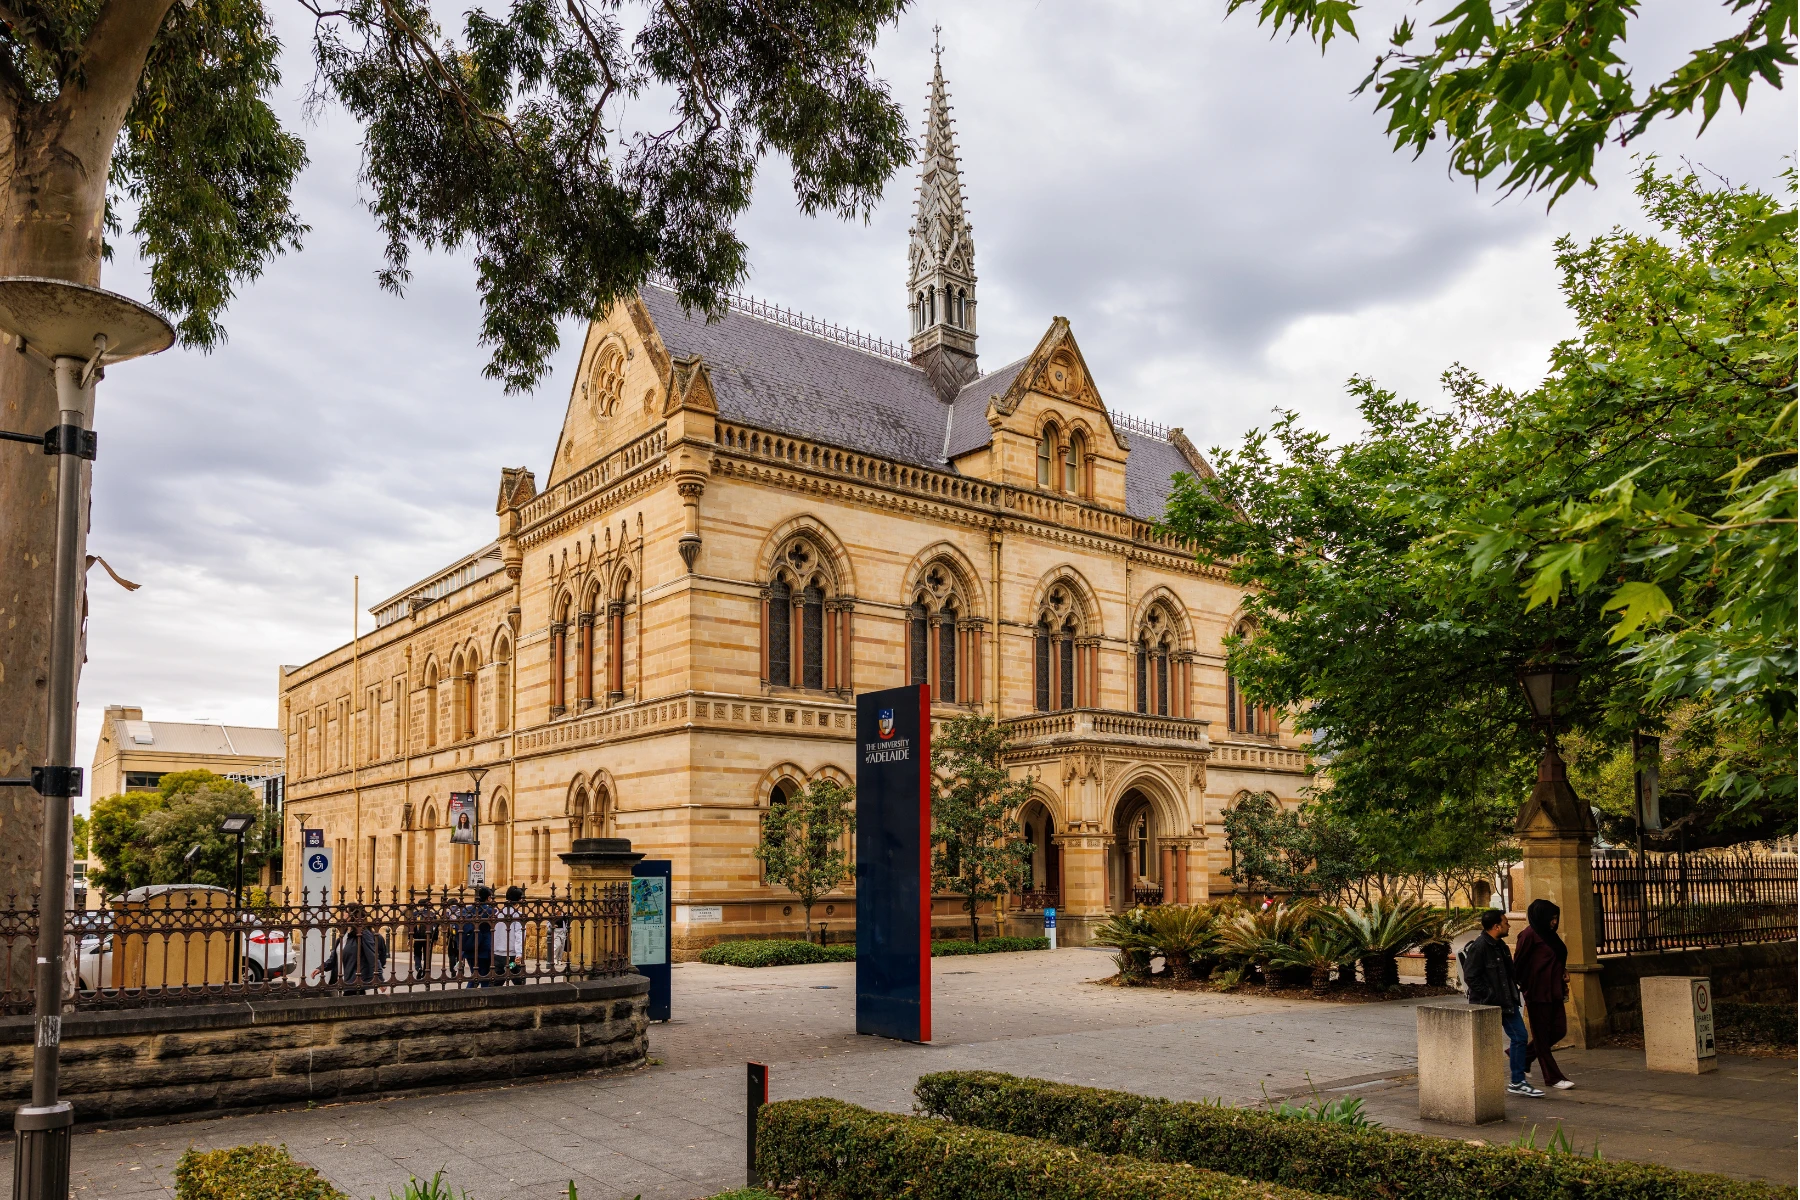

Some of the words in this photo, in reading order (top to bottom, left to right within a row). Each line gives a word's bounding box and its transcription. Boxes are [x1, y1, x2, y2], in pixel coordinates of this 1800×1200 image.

[865, 743, 876, 751] THE
[877, 739, 909, 750] UNIVERSITY
[870, 749, 909, 763] ADELAIDE
[1699, 992, 1706, 1005] 10
[1696, 1013, 1711, 1023] SHARED
[1699, 1024, 1710, 1032] ZONE
